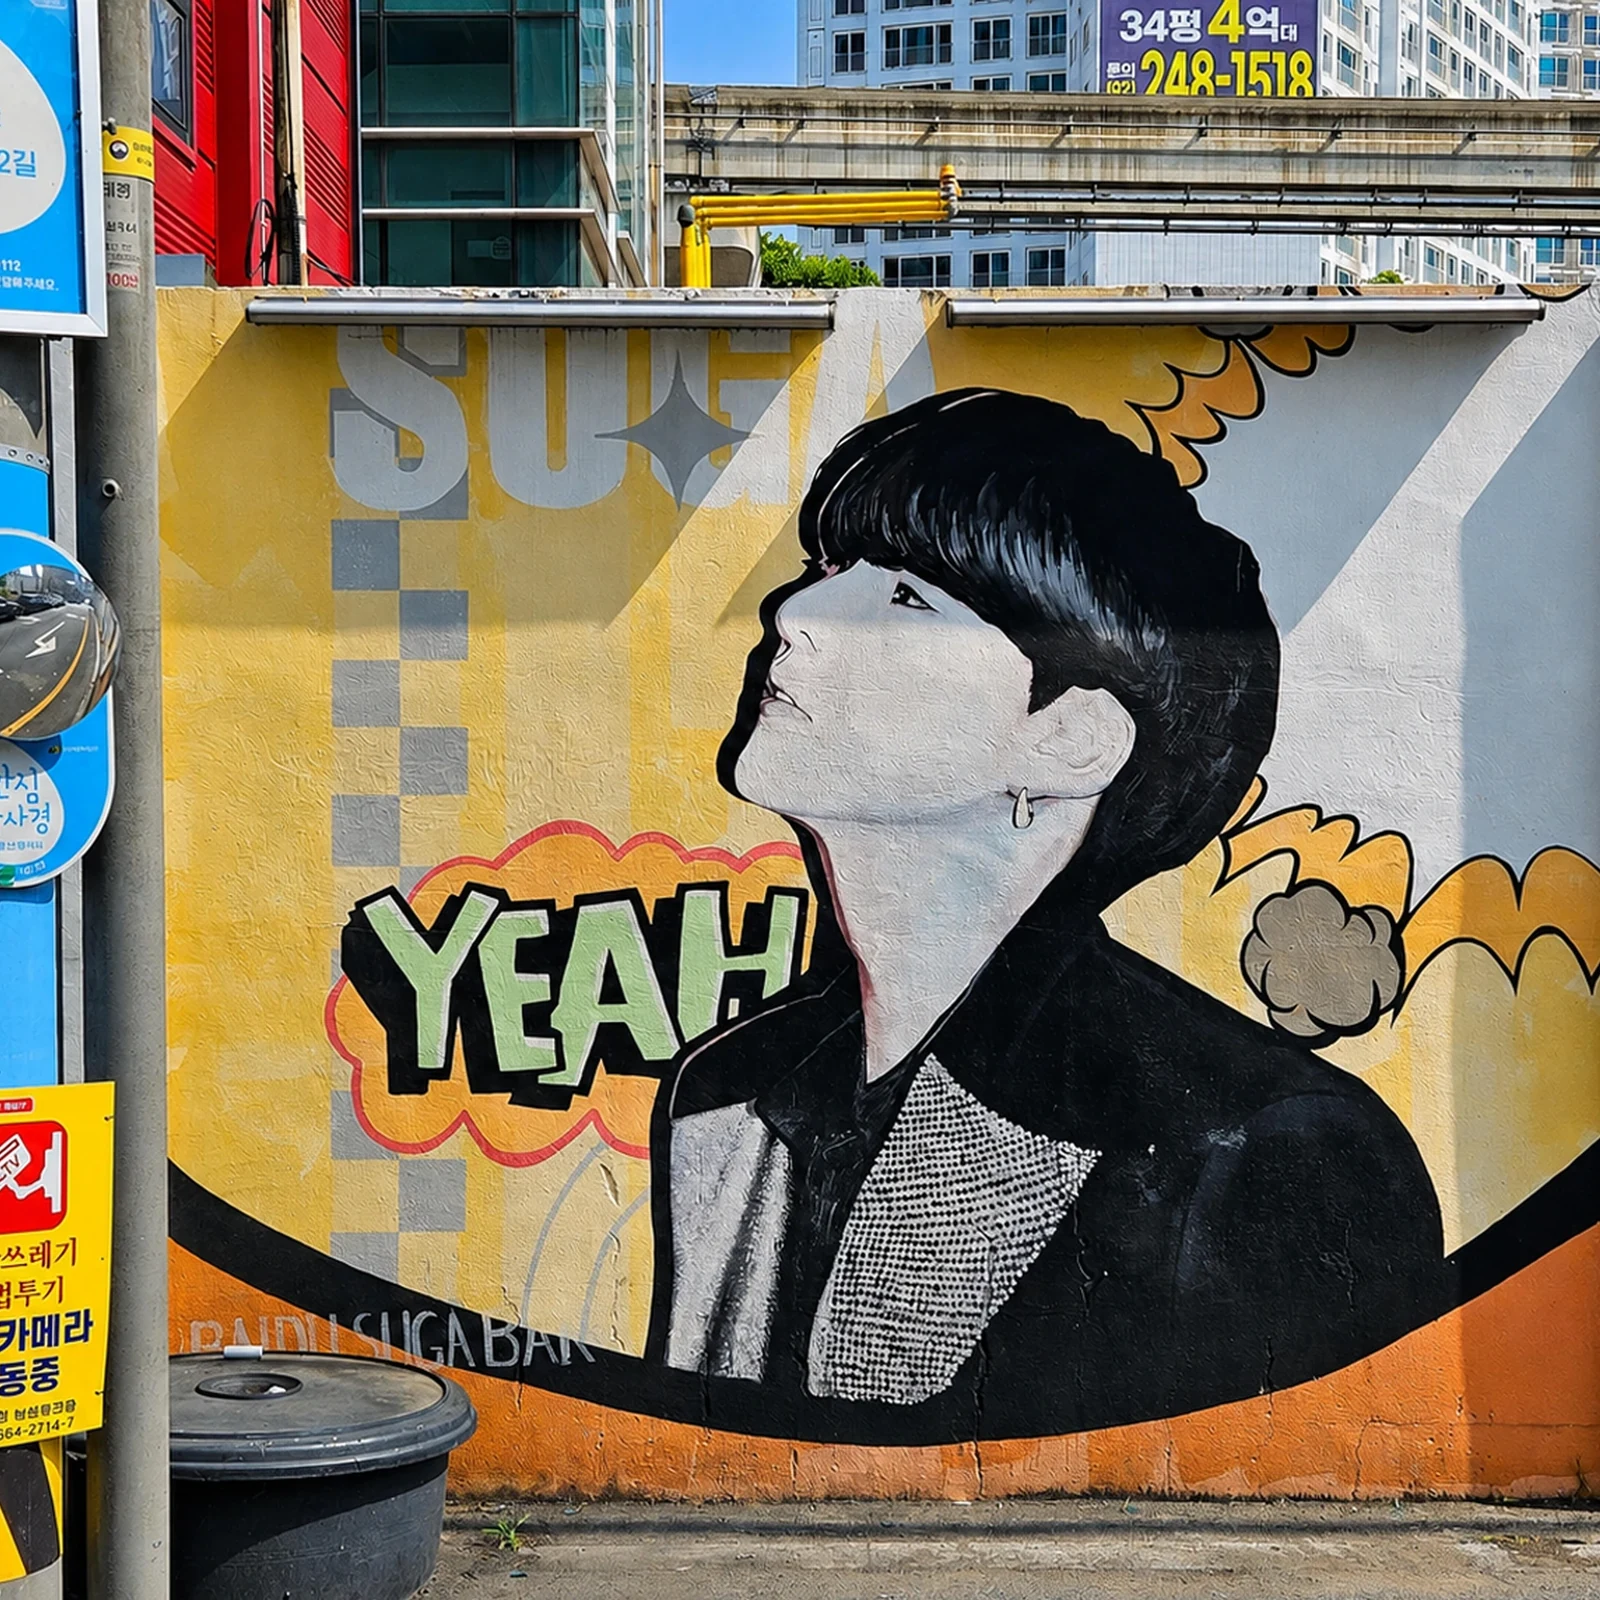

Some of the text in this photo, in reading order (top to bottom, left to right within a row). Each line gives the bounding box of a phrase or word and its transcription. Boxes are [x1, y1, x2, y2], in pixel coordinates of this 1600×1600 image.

[1120, 9, 1201, 43] 34평
[1140, 50, 1314, 97] 248-1518
[330, 289, 936, 512] SUGA
[0, 802, 50, 835] 사경
[361, 887, 800, 1086] YEAH
[0, 1309, 94, 1352] 카메라
